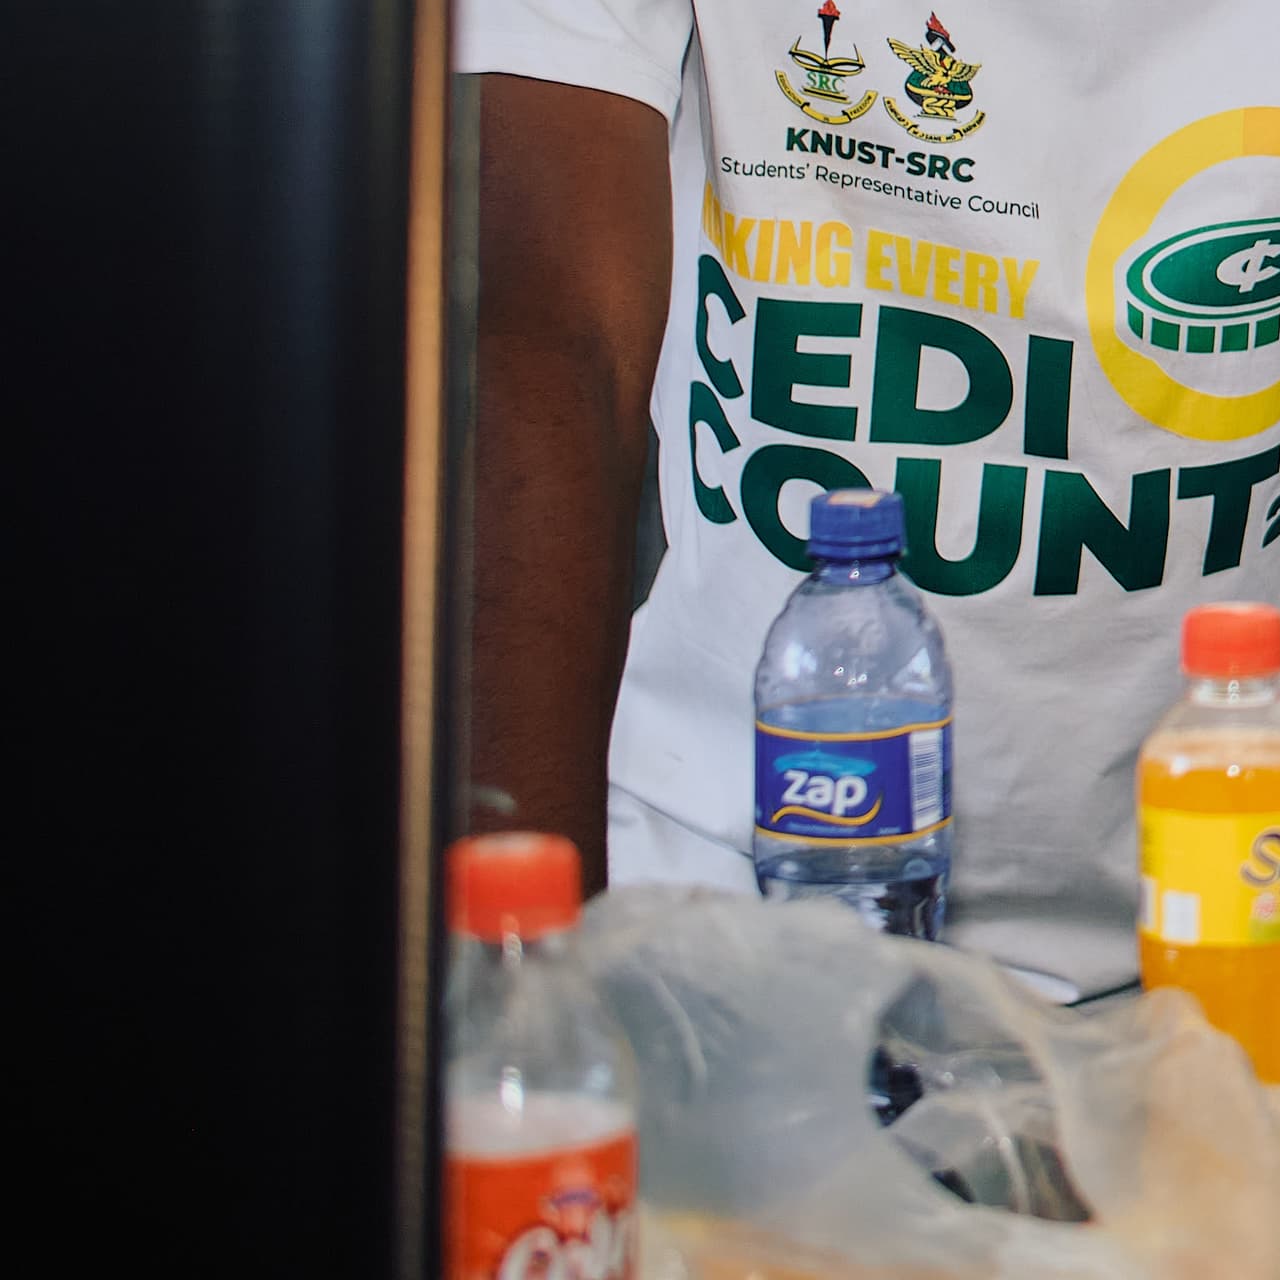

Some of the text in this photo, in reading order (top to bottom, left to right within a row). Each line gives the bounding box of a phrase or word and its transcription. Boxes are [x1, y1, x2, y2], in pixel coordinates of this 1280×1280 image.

[806, 71, 846, 95] SRC
[785, 127, 976, 183] KNUST-SRC
[816, 165, 962, 210] Representative
[968, 195, 1040, 219] Council
[865, 228, 1041, 320] EVERY
[695, 253, 1074, 460] CEDI
[781, 769, 868, 817] zap
